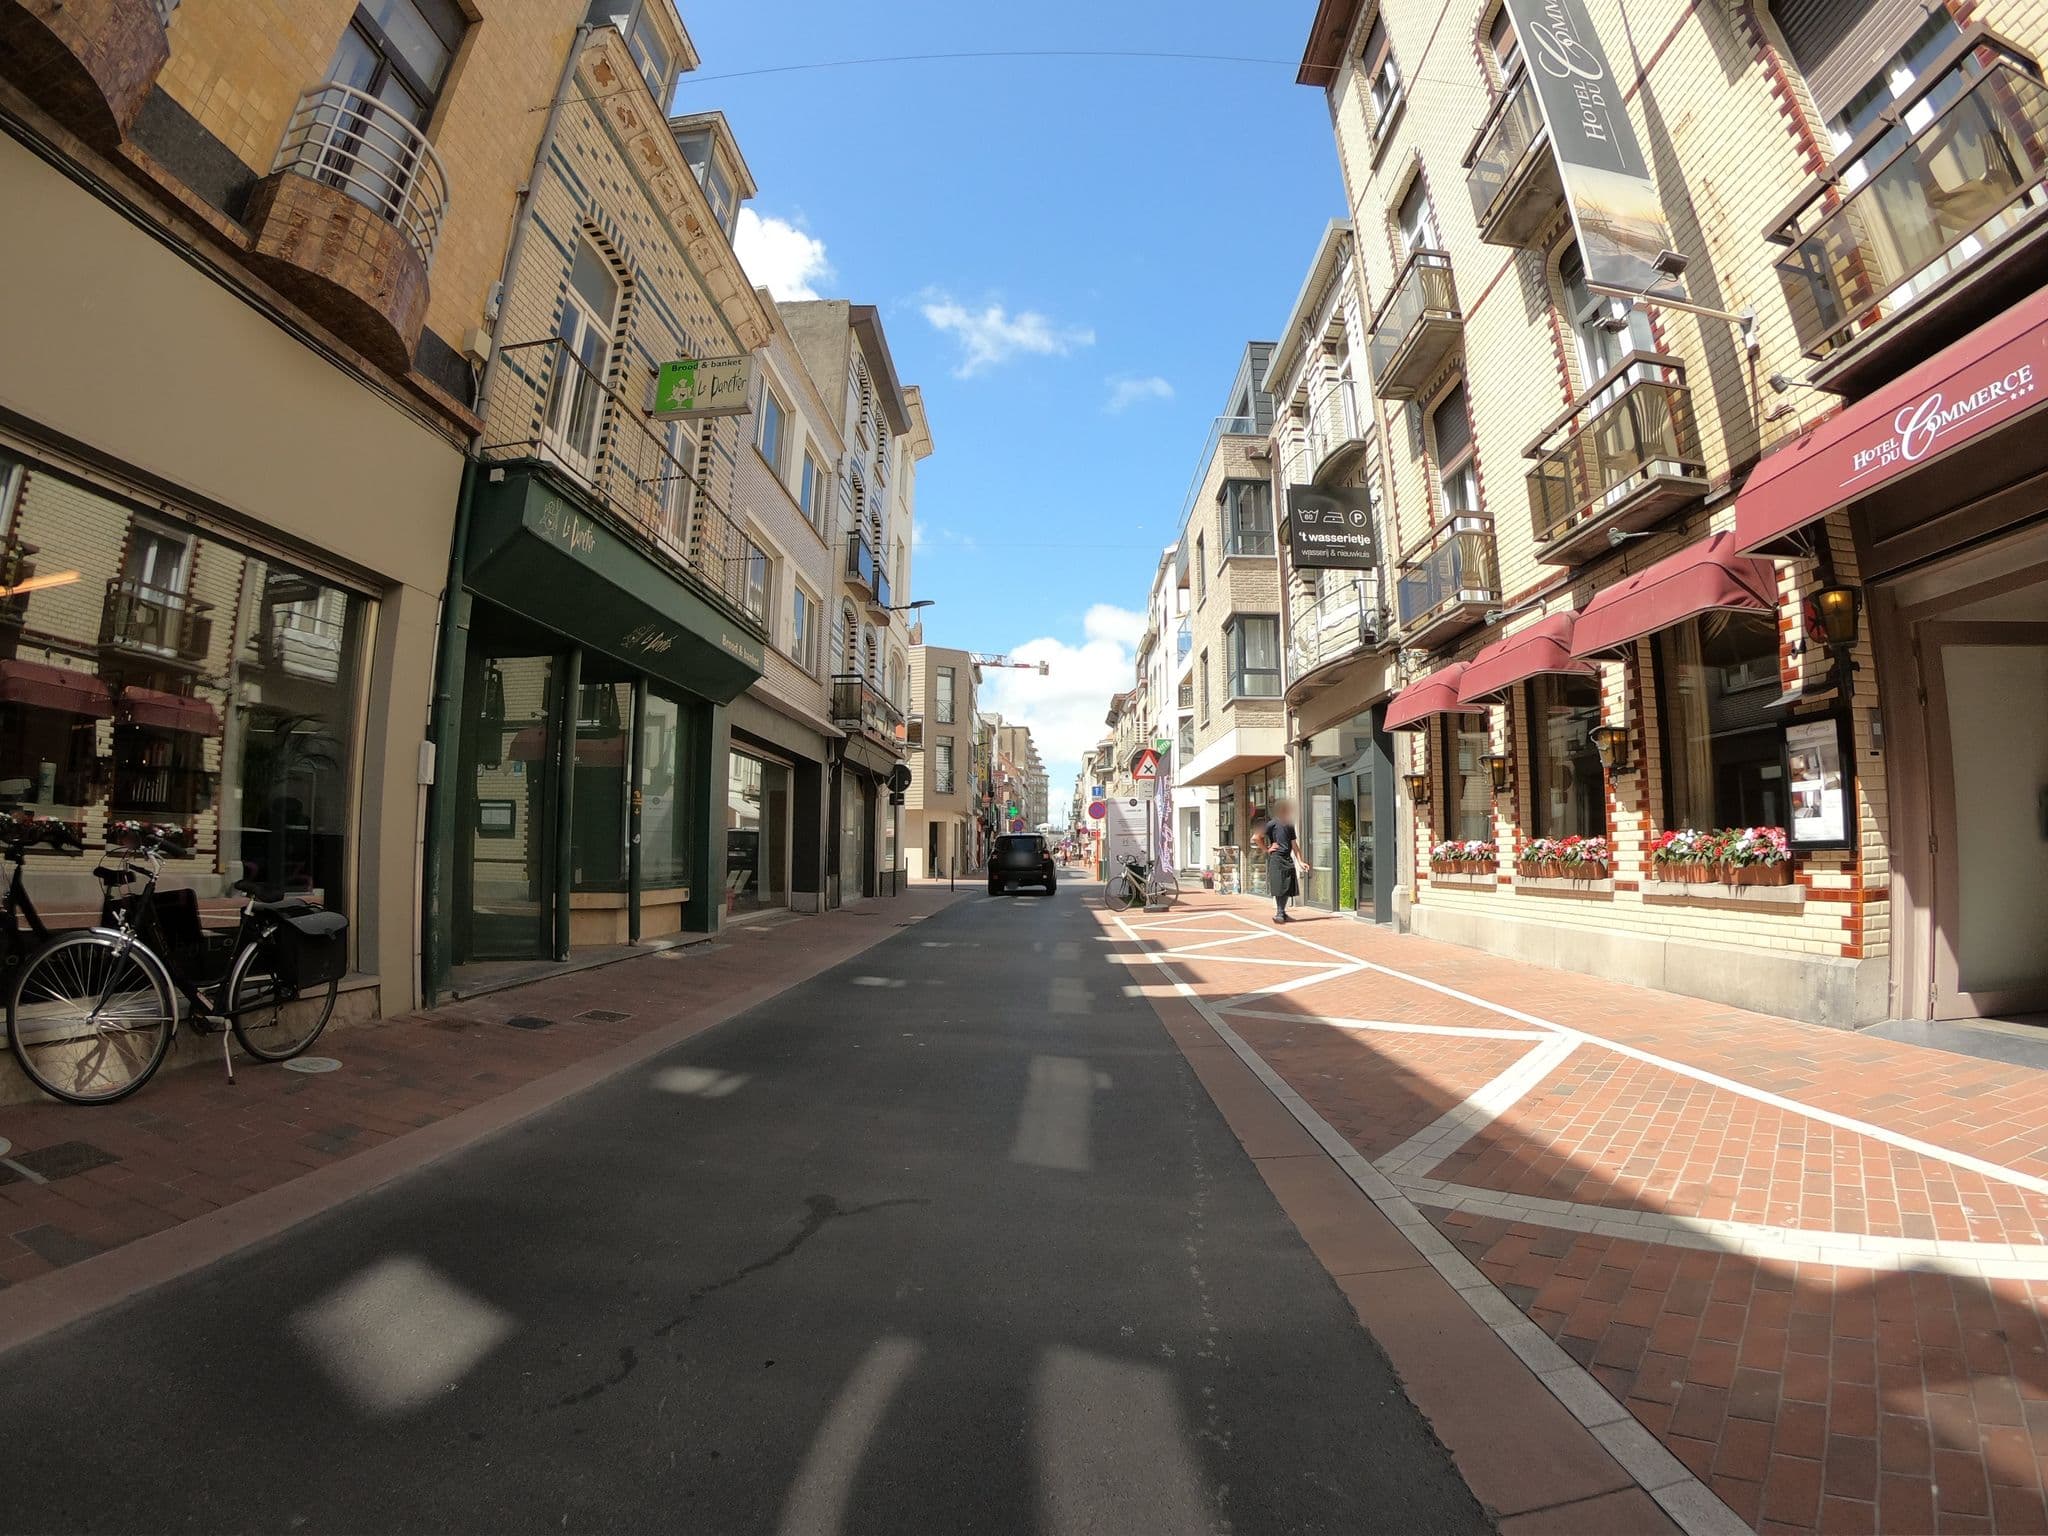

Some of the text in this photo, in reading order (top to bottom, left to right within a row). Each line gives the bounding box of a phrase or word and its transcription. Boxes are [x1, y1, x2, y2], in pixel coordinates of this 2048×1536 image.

[1573, 80, 1608, 142] HOTEL
[1585, 81, 1606, 111] DU
[671, 359, 742, 372] Brood & banket
[1880, 364, 2033, 467] DU COMMERCE
[1852, 437, 1899, 471] HOTEL
[1302, 549, 1370, 558] wasserij & nieuwkuis
[1308, 533, 1371, 546] wasserietje
